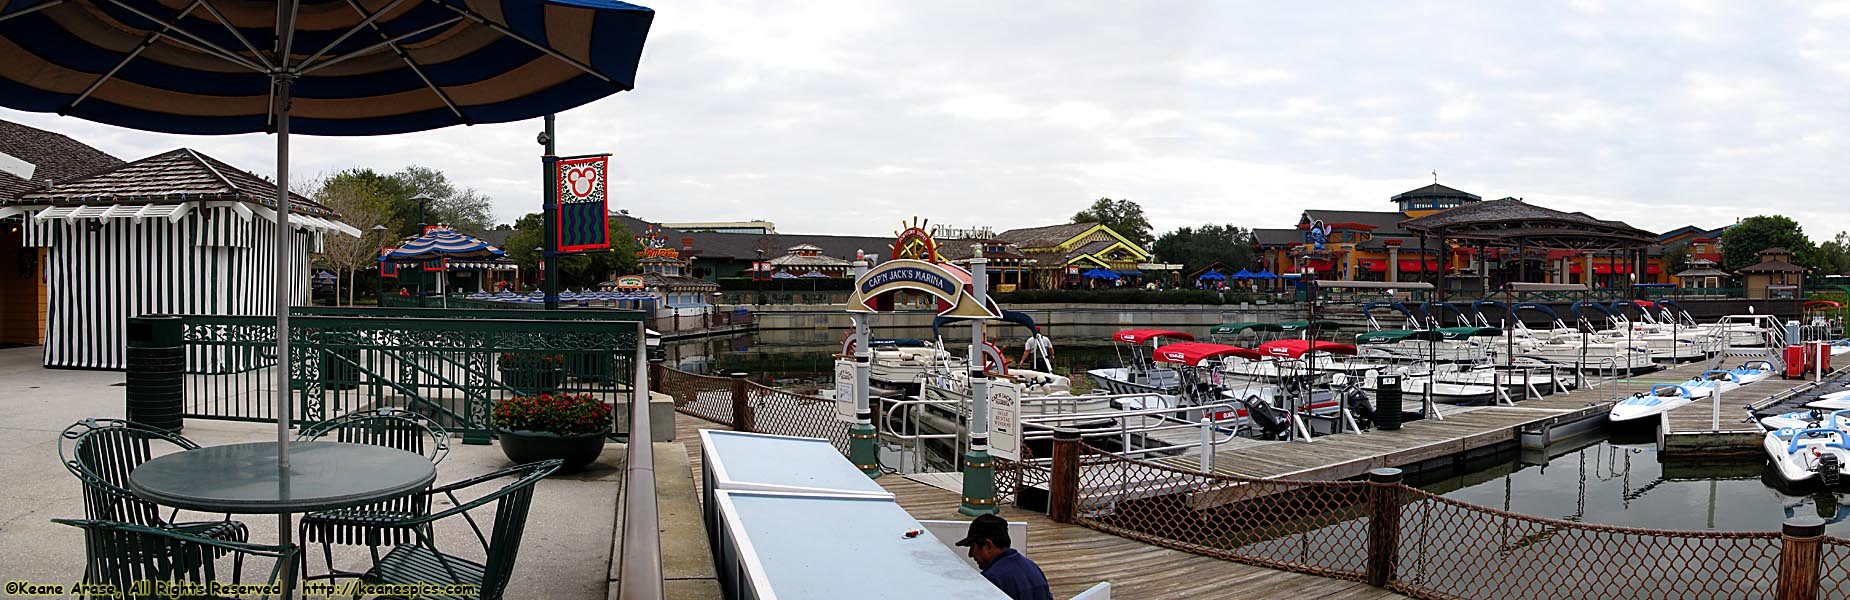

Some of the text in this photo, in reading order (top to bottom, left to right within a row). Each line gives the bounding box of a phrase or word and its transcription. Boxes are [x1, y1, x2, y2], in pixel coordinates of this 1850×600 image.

[931, 223, 993, 240] Ghirardelli
[868, 269, 944, 288] CAP'N JACK'S MARINA
